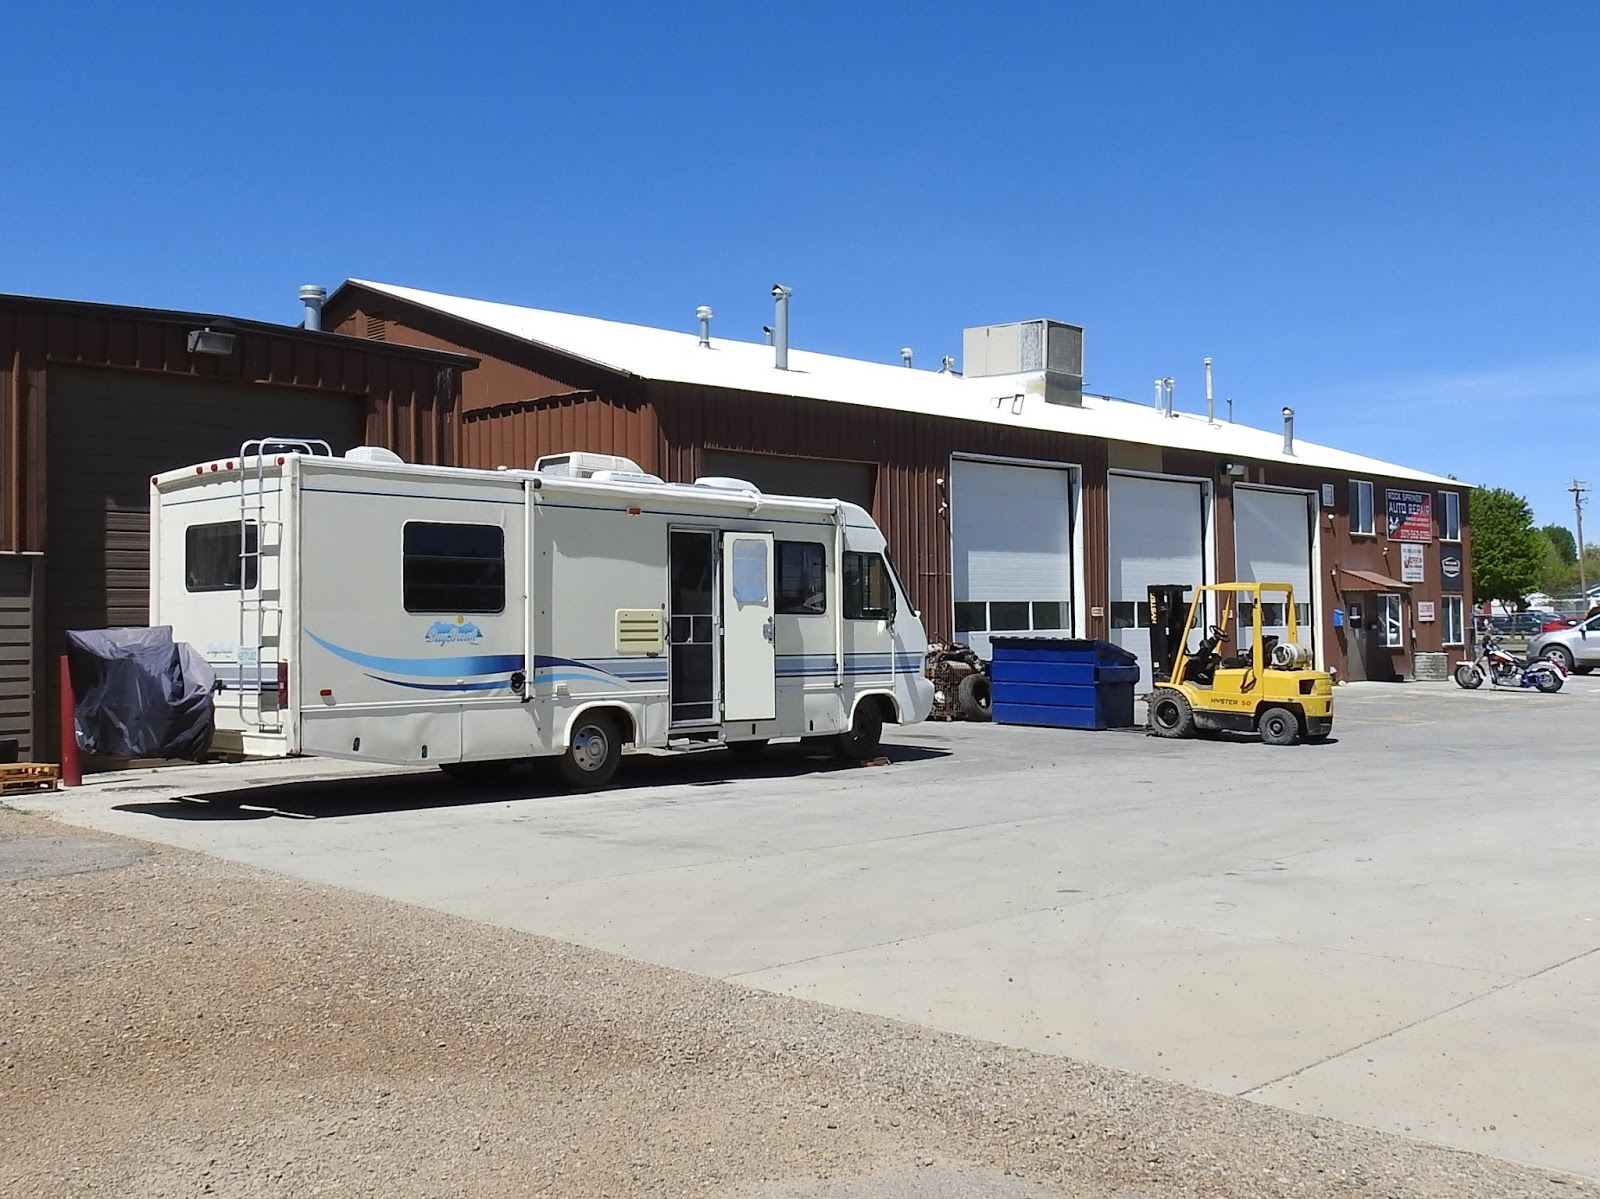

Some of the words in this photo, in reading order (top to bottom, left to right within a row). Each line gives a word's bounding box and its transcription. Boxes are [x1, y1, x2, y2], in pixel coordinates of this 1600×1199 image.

[1387, 491, 1401, 500] ROCK
[1402, 493, 1422, 503] SPRINGS
[1389, 501, 1407, 514] AUTO
[1408, 503, 1430, 516] REPAIR
[1150, 592, 1158, 624] HYSTER
